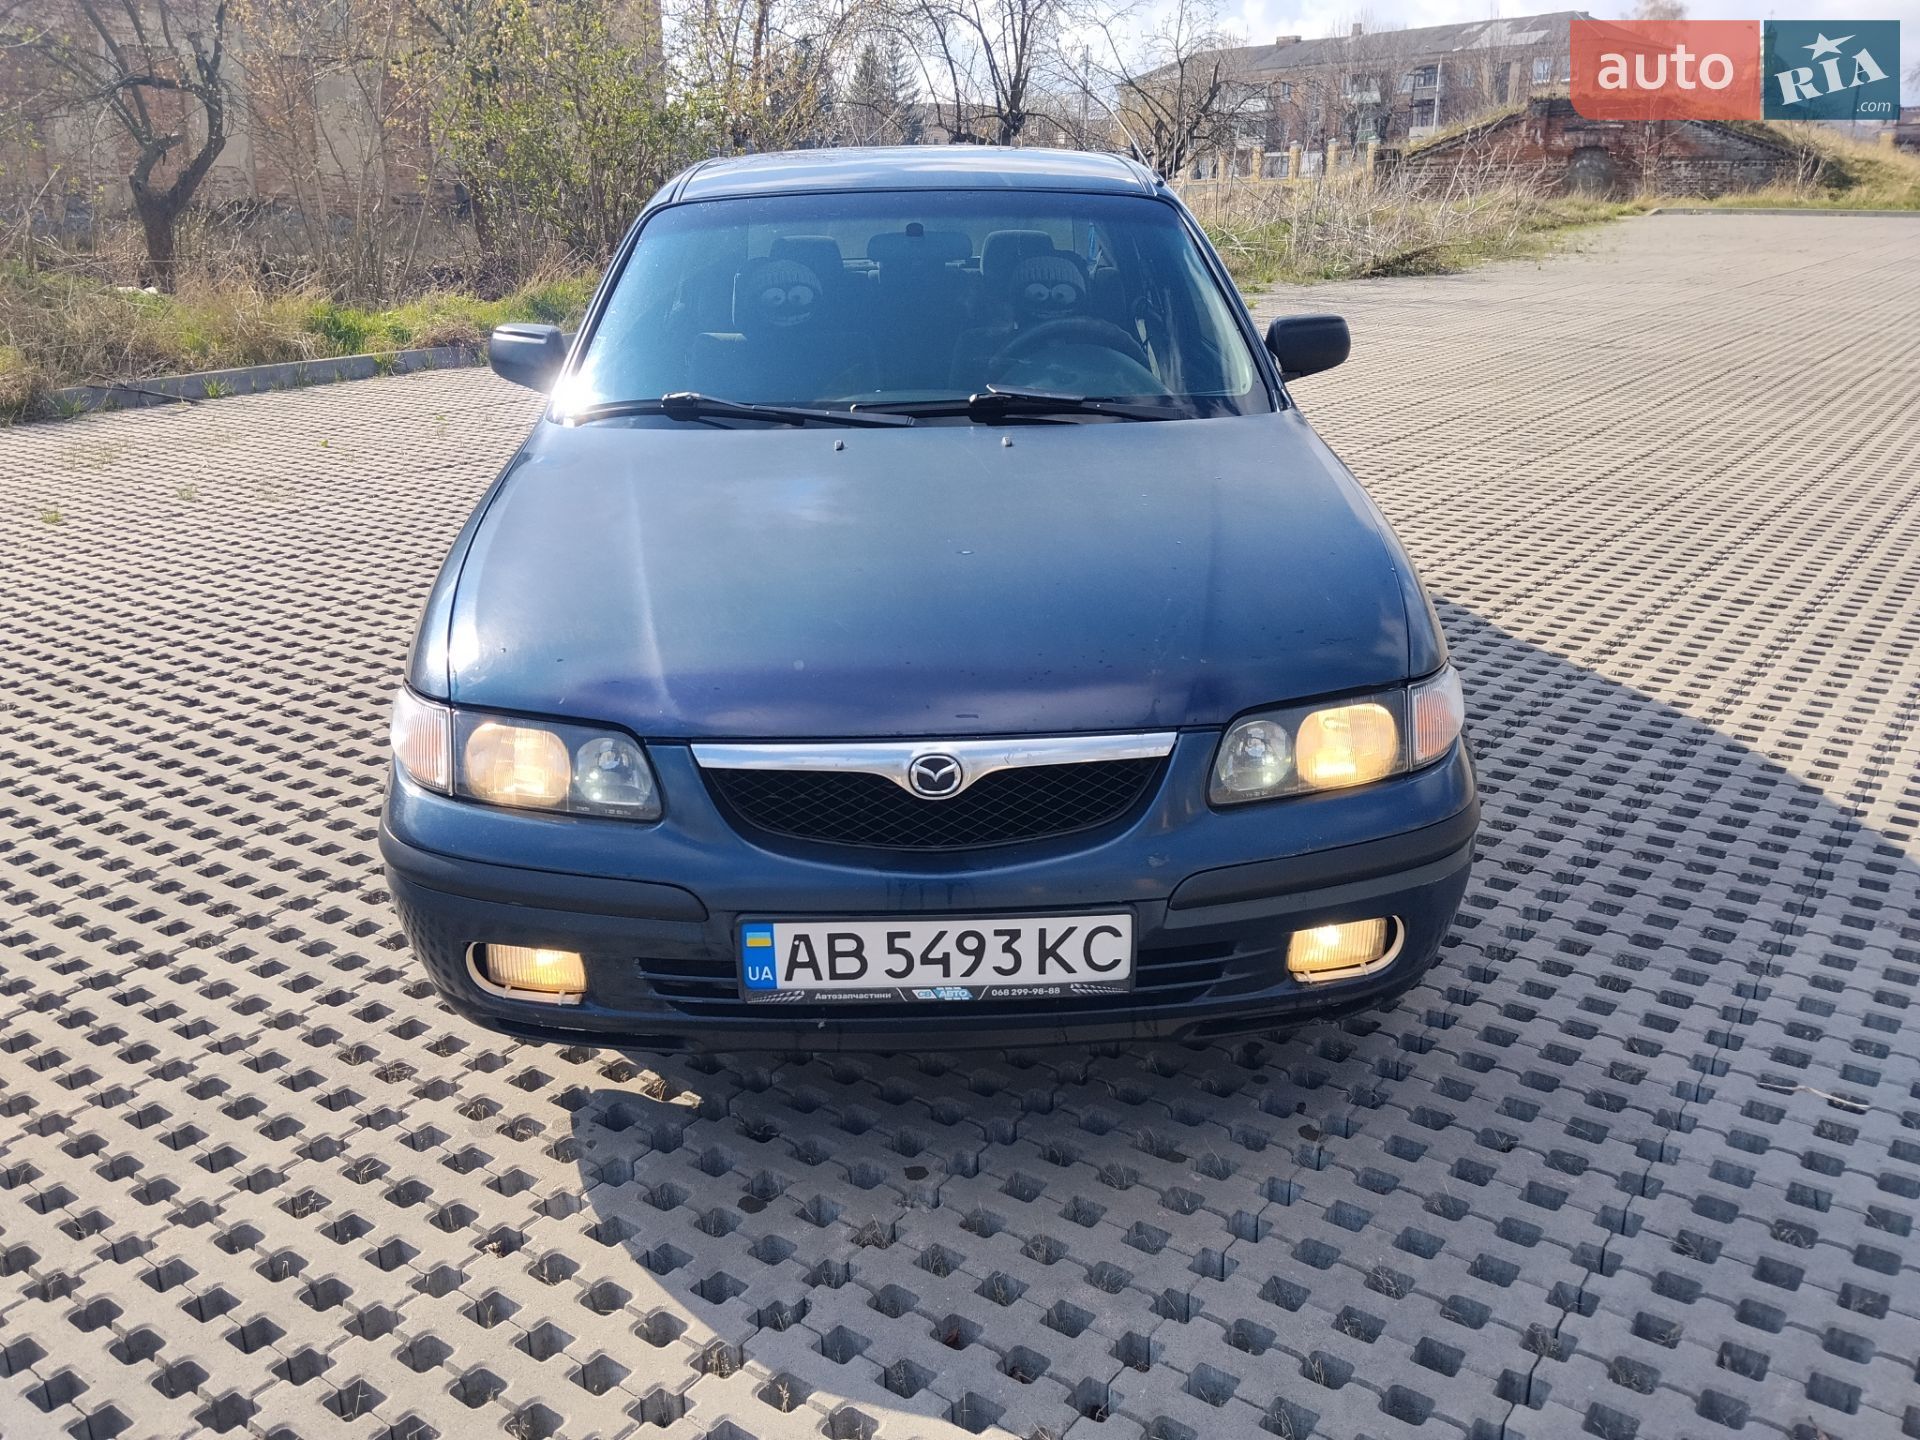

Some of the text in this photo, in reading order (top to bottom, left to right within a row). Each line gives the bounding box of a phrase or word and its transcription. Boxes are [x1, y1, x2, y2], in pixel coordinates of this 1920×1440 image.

[784, 925, 1123, 982] AB 5493 KC
[748, 966, 774, 982] UA
[815, 992, 892, 1000] Автозапчастини
